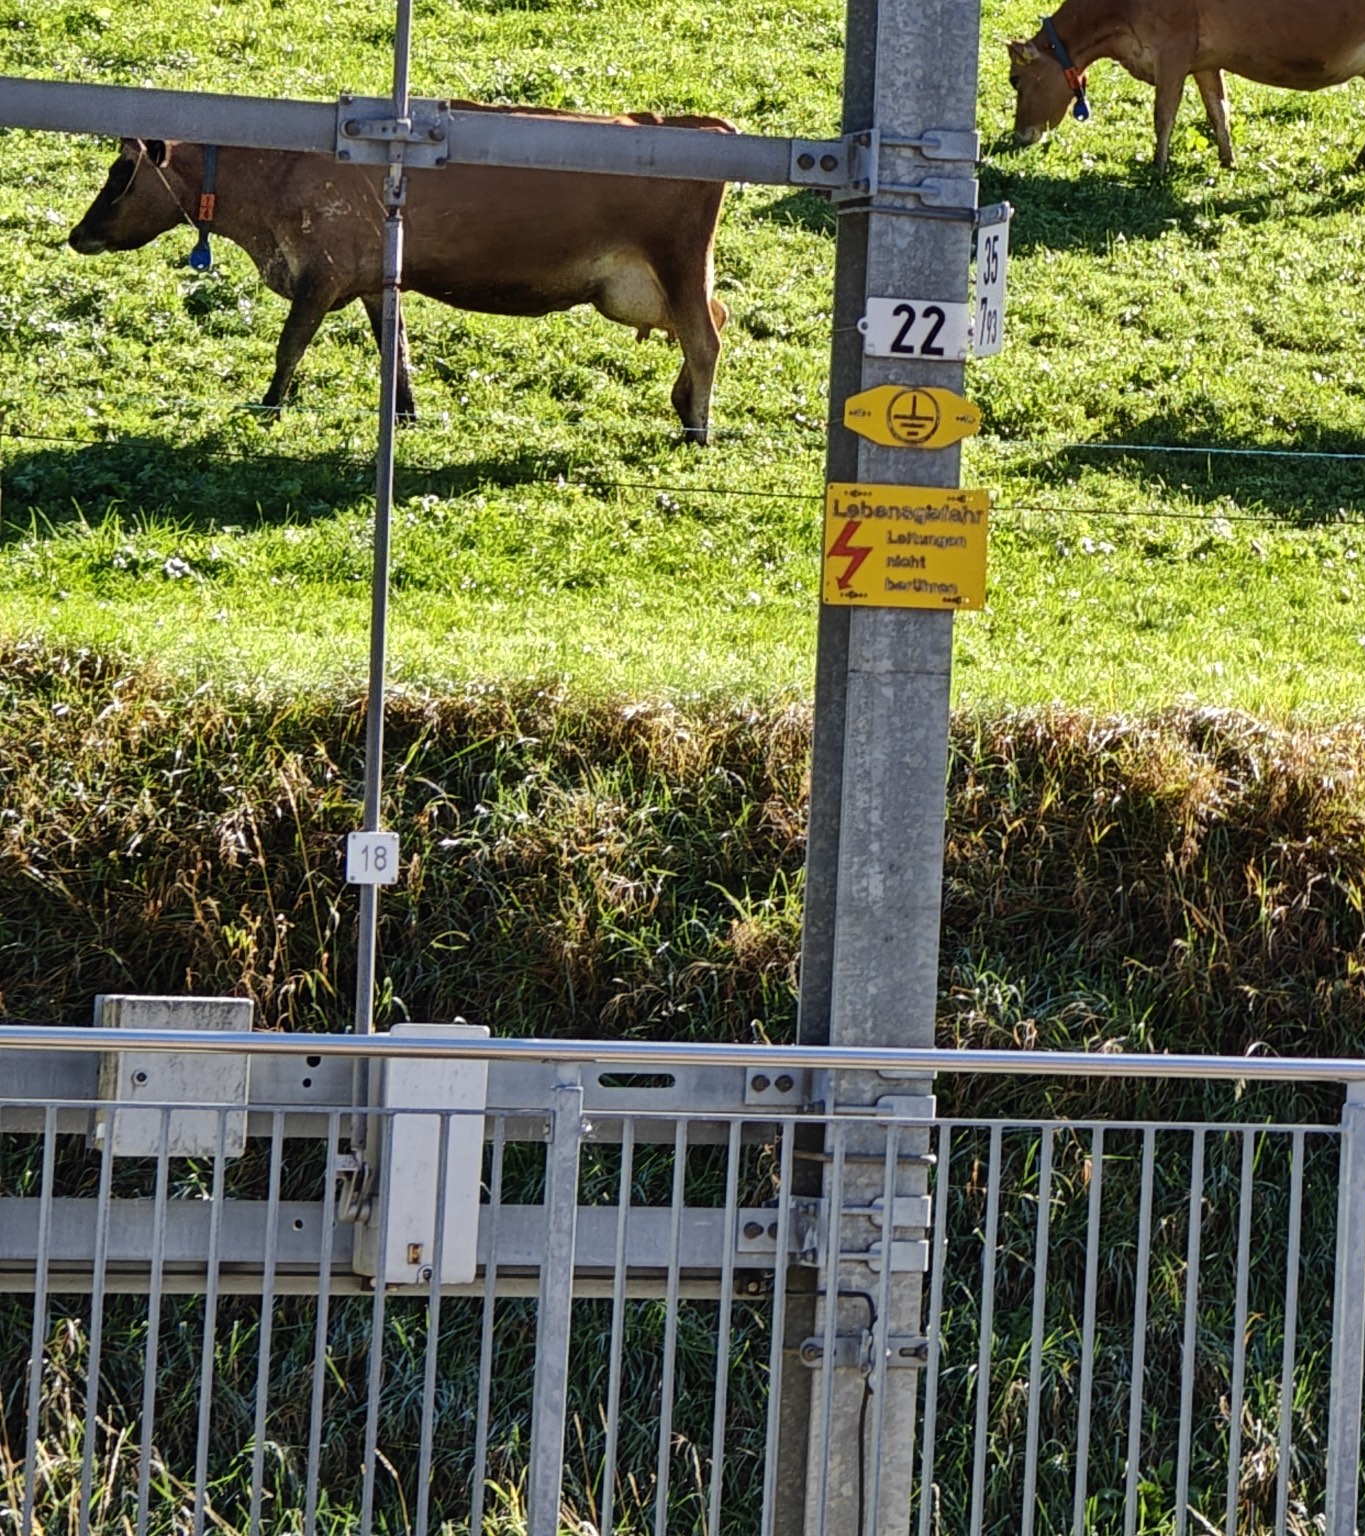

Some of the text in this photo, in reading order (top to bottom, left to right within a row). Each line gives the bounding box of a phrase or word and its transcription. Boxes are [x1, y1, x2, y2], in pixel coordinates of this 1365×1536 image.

[983, 235, 1000, 286] 35
[890, 303, 946, 357] 22
[833, 499, 985, 525] Lebensgefahr
[886, 530, 967, 549] Leitungen
[886, 555, 927, 569] nicht
[884, 576, 959, 594] berühren
[361, 845, 387, 872] 18
